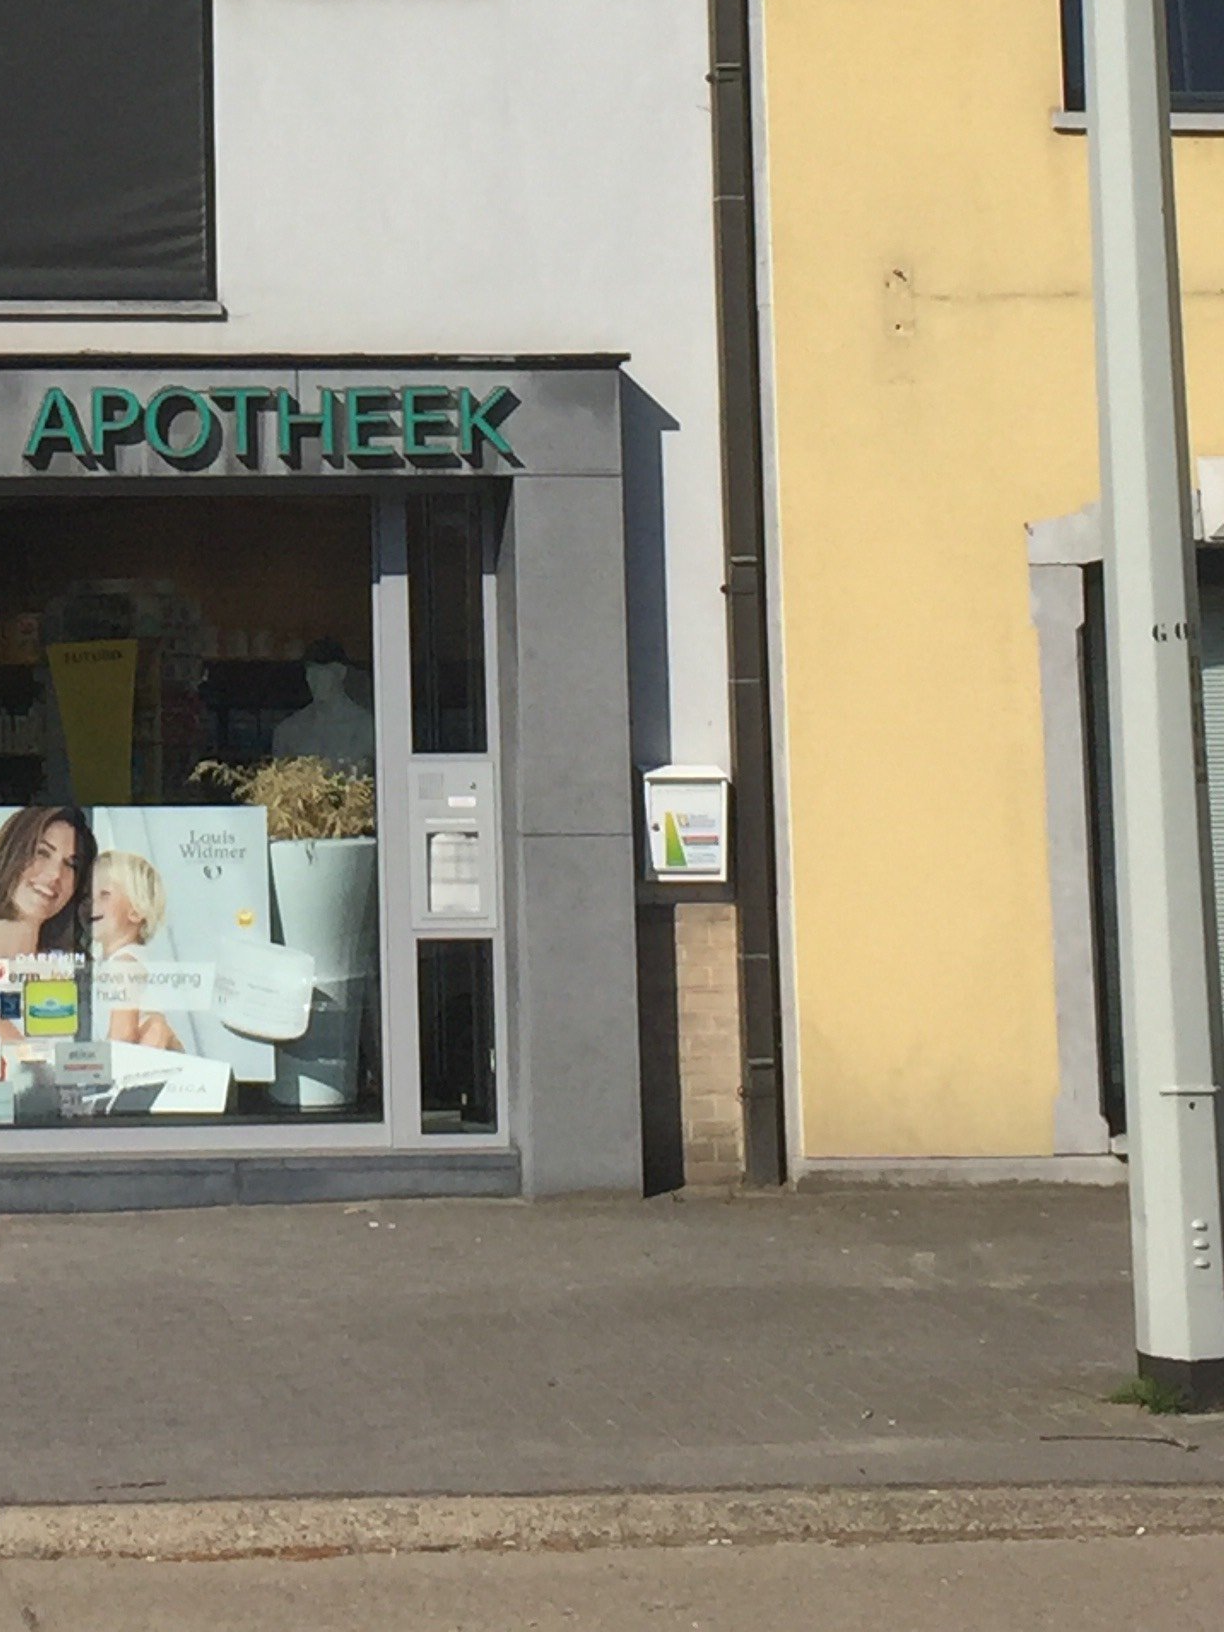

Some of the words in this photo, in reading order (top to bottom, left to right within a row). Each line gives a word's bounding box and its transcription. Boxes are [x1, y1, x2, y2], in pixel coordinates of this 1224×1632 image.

[23, 385, 514, 457] APOTHEEK
[189, 830, 235, 844] Louis
[179, 844, 246, 858] Widmer
[128, 970, 202, 989] verzorging
